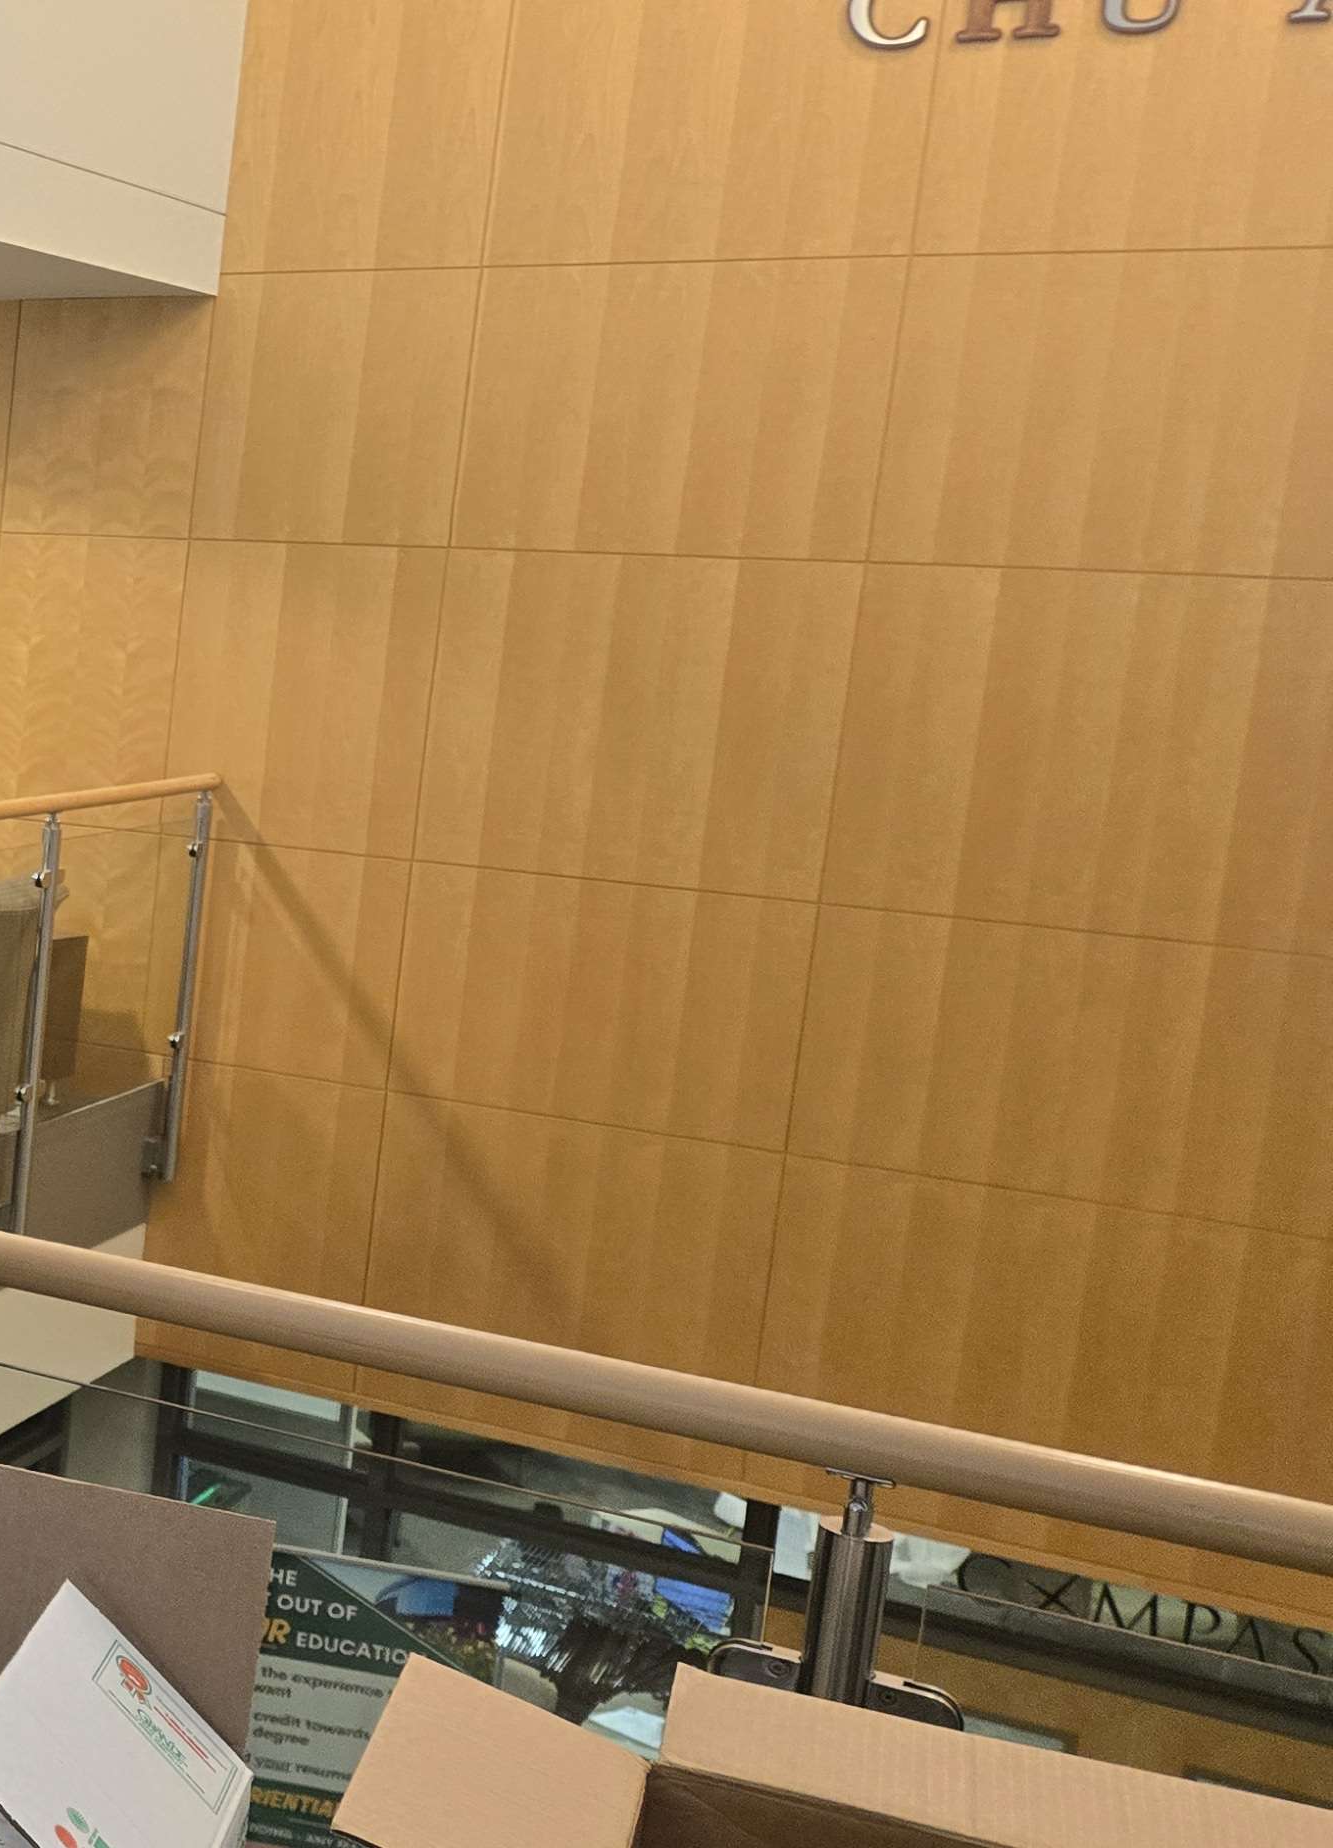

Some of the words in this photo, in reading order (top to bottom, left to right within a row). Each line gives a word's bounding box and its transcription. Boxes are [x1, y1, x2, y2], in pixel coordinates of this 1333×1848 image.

[269, 1567, 298, 1587] HE
[277, 1594, 322, 1616] OUT
[328, 1602, 358, 1621] OF
[296, 1632, 408, 1666] EDUCATIO
[261, 1666, 287, 1680] the
[253, 1712, 301, 1728] credit
[253, 1726, 310, 1746] degree
[251, 1786, 336, 1817] RIENTIA
